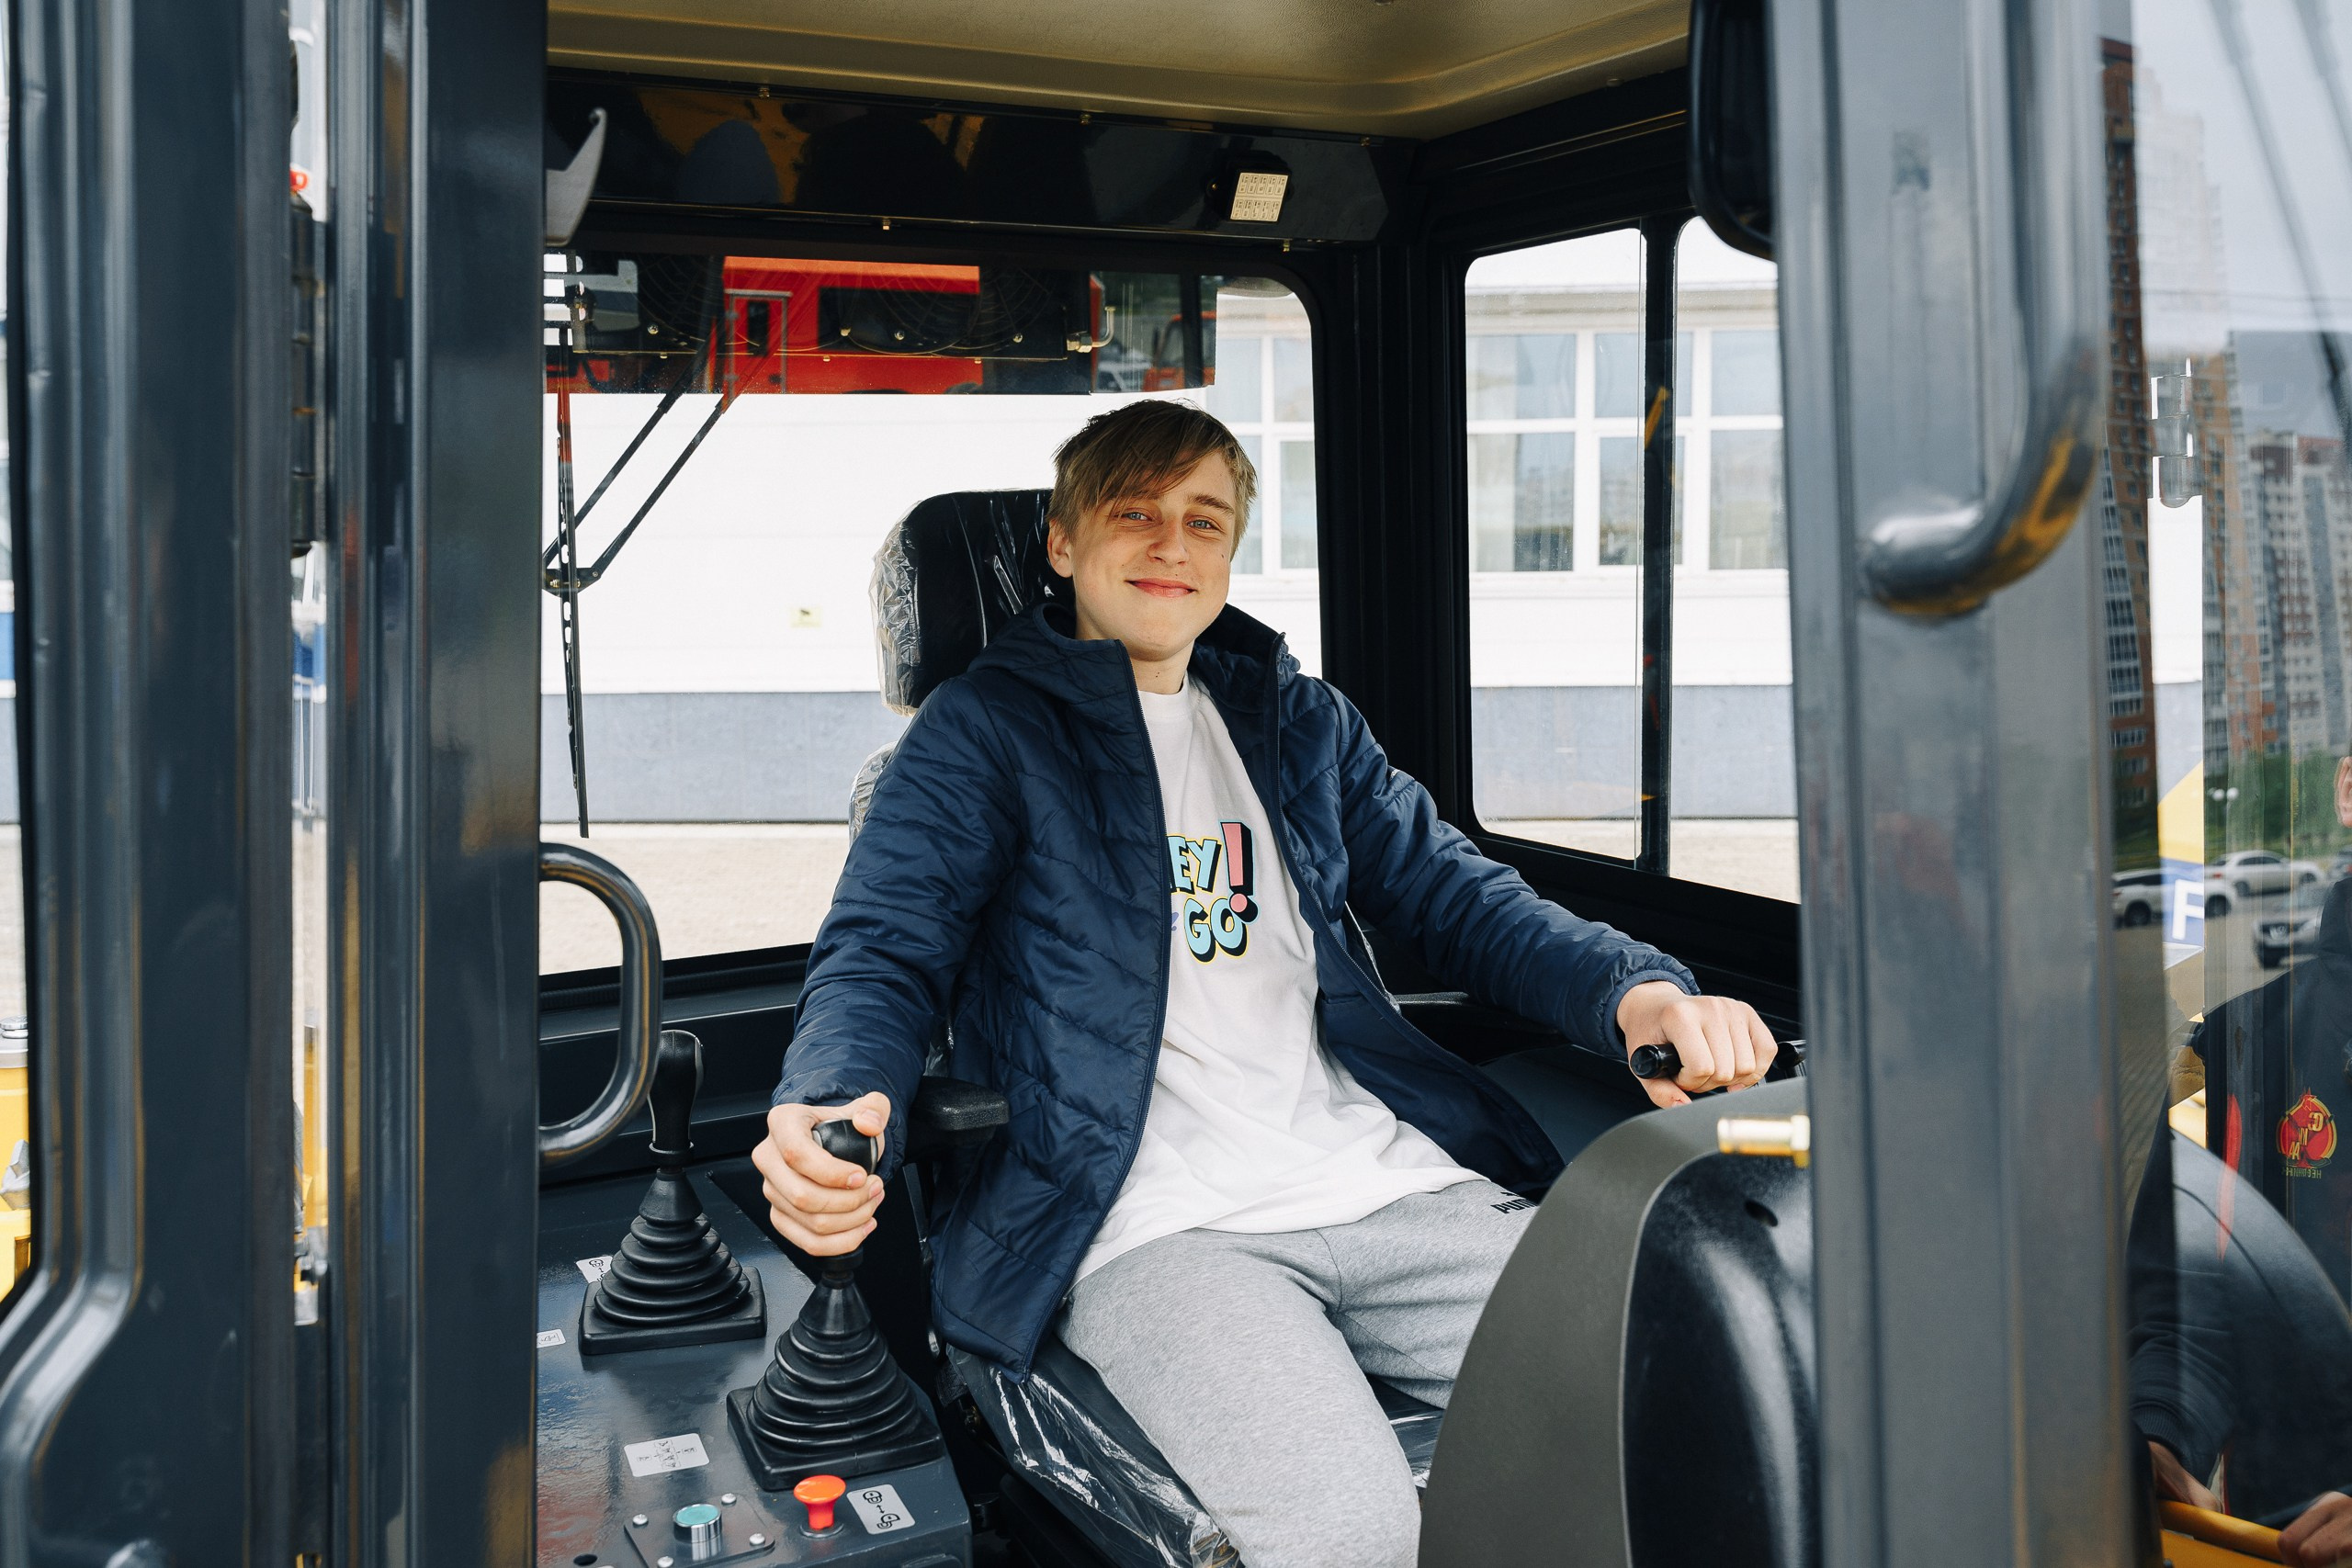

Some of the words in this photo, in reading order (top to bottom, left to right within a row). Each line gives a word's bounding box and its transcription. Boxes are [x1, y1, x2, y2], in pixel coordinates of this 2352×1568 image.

[1167, 820, 1260, 923] EY!
[1184, 897, 1250, 964] GO
[1490, 1198, 1539, 1214] PU
